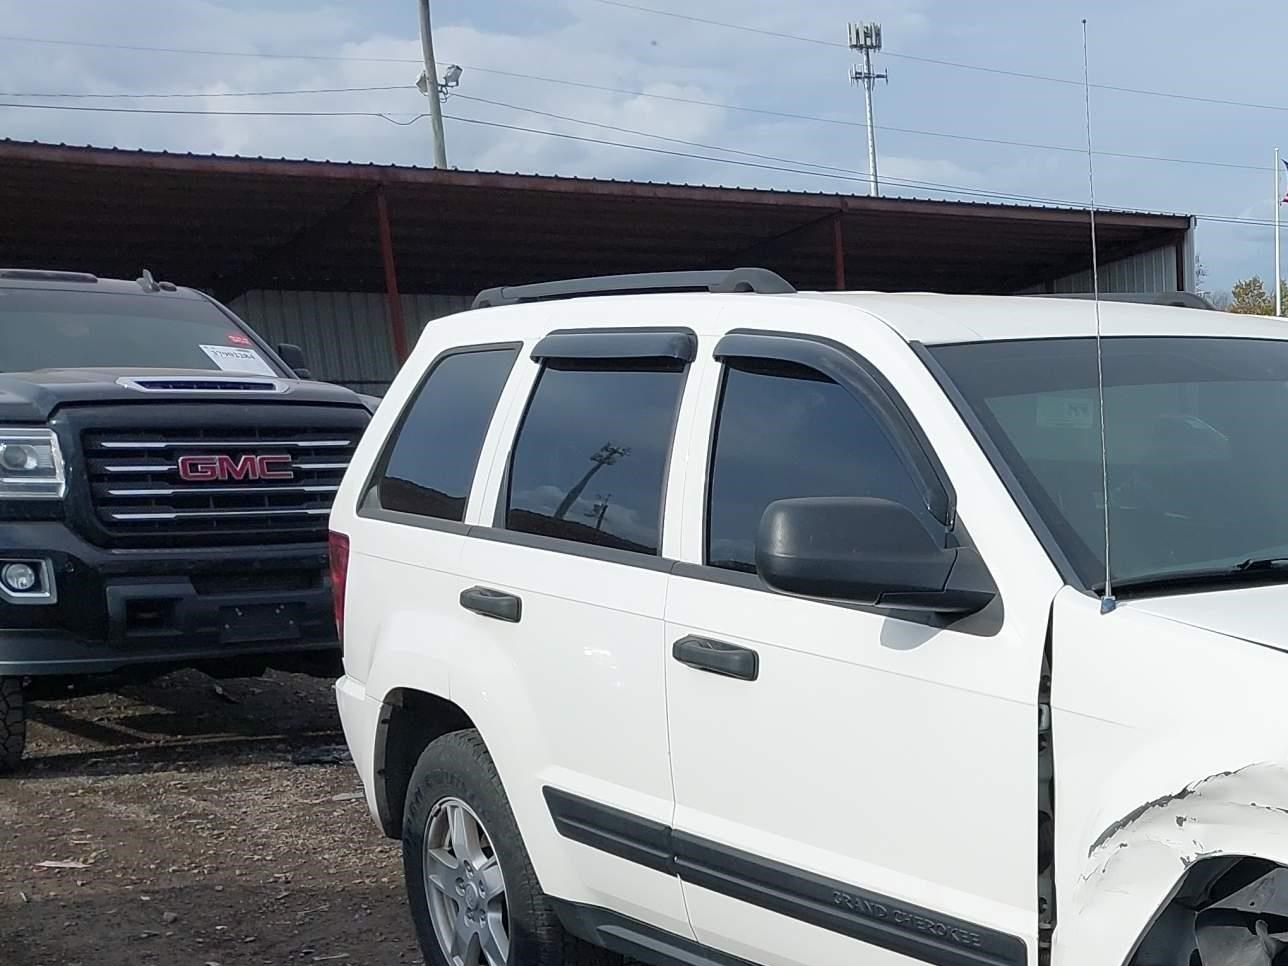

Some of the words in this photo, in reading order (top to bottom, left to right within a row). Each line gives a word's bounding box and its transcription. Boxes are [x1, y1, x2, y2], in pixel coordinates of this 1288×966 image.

[178, 455, 293, 480] GMC
[832, 890, 888, 918] GRAND
[893, 909, 982, 948] CHEROKEE
